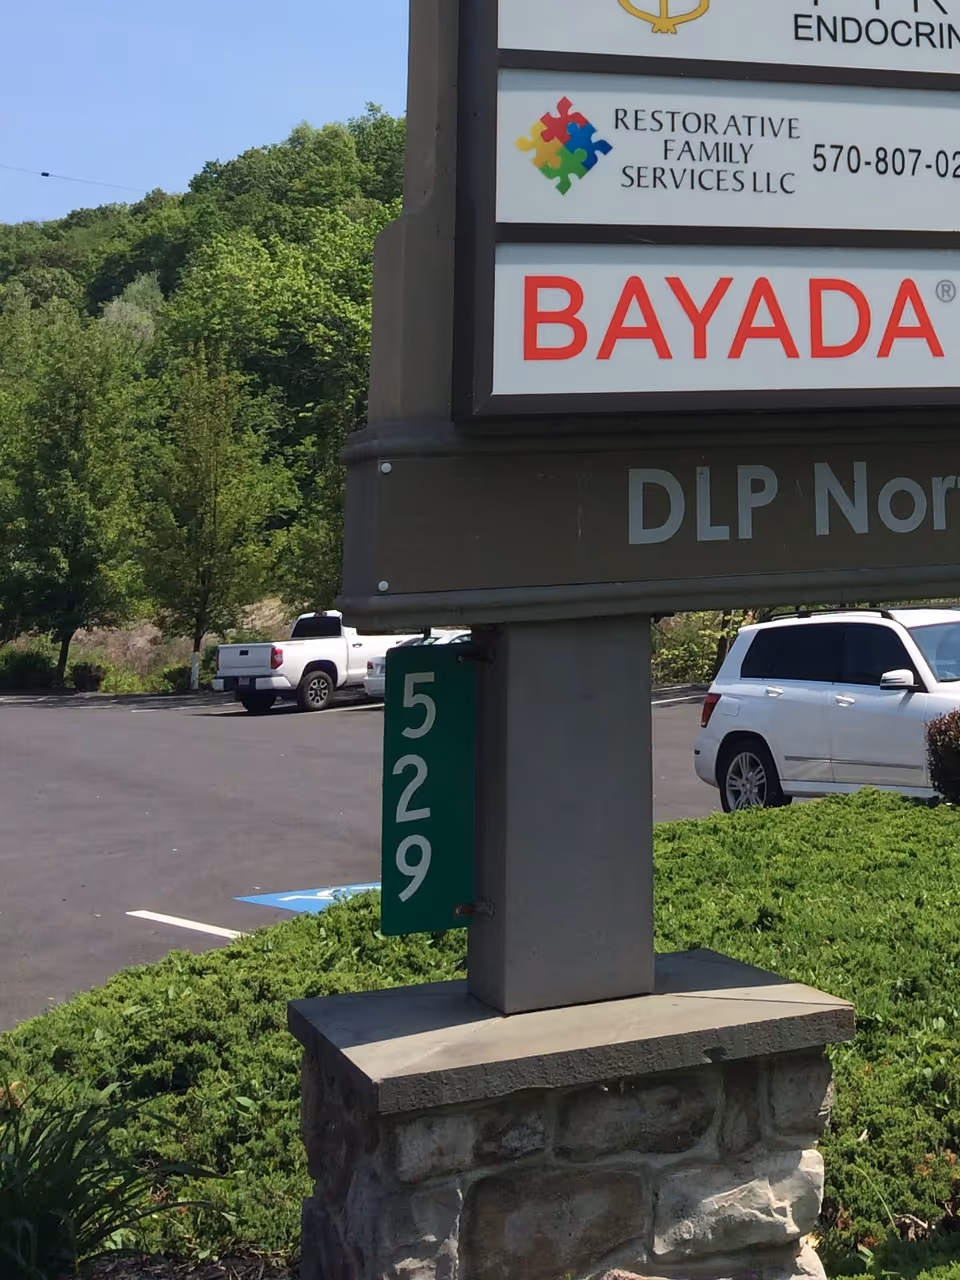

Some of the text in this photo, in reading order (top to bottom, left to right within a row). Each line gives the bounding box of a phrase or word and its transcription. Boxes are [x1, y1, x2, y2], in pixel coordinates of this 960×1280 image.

[614, 107, 801, 139] RESTORATIVE
[663, 139, 753, 164] FAMILY
[620, 165, 795, 195] SERVICES LLC
[627, 463, 779, 546] DLP
